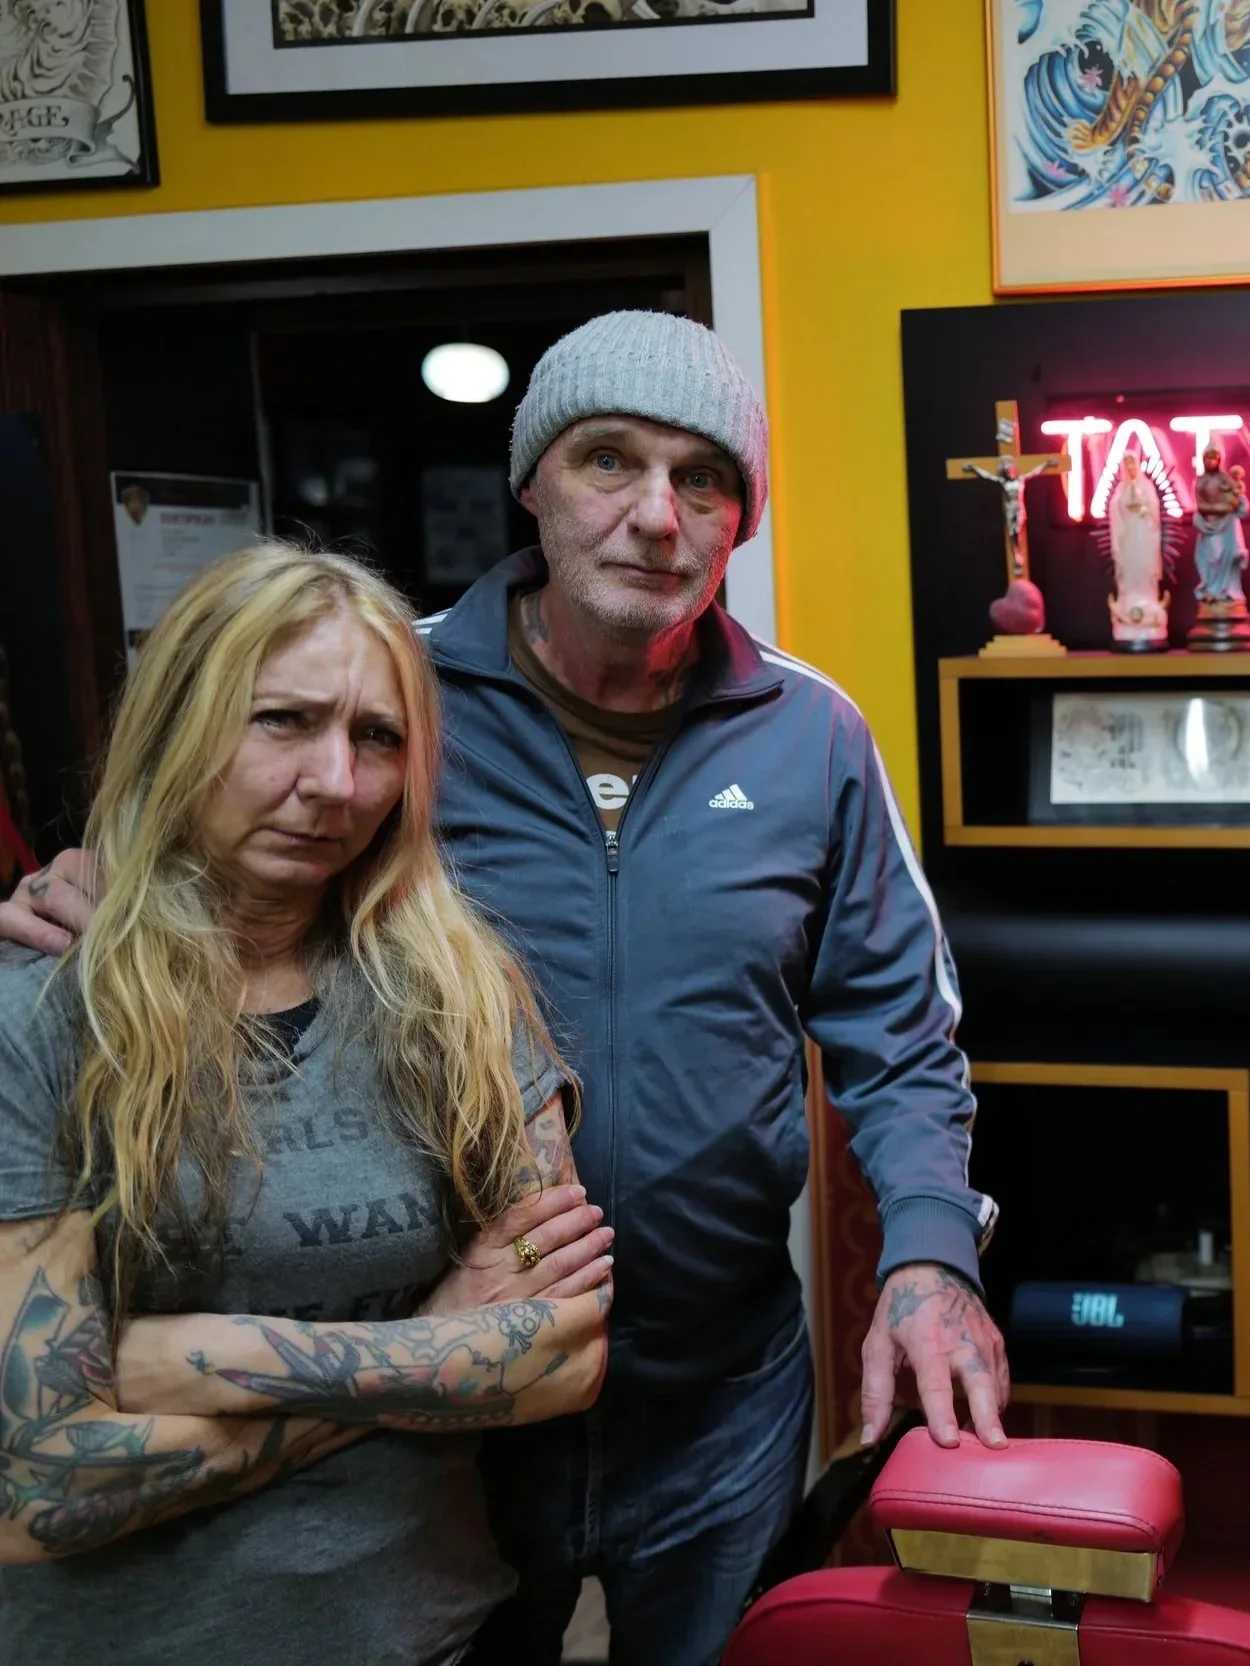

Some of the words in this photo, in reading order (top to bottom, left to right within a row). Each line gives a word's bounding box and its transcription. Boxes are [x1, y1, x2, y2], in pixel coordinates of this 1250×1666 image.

[0, 105, 70, 137] AGE
[709, 799, 754, 811] adidas
[1071, 1292, 1125, 1328] JBL
